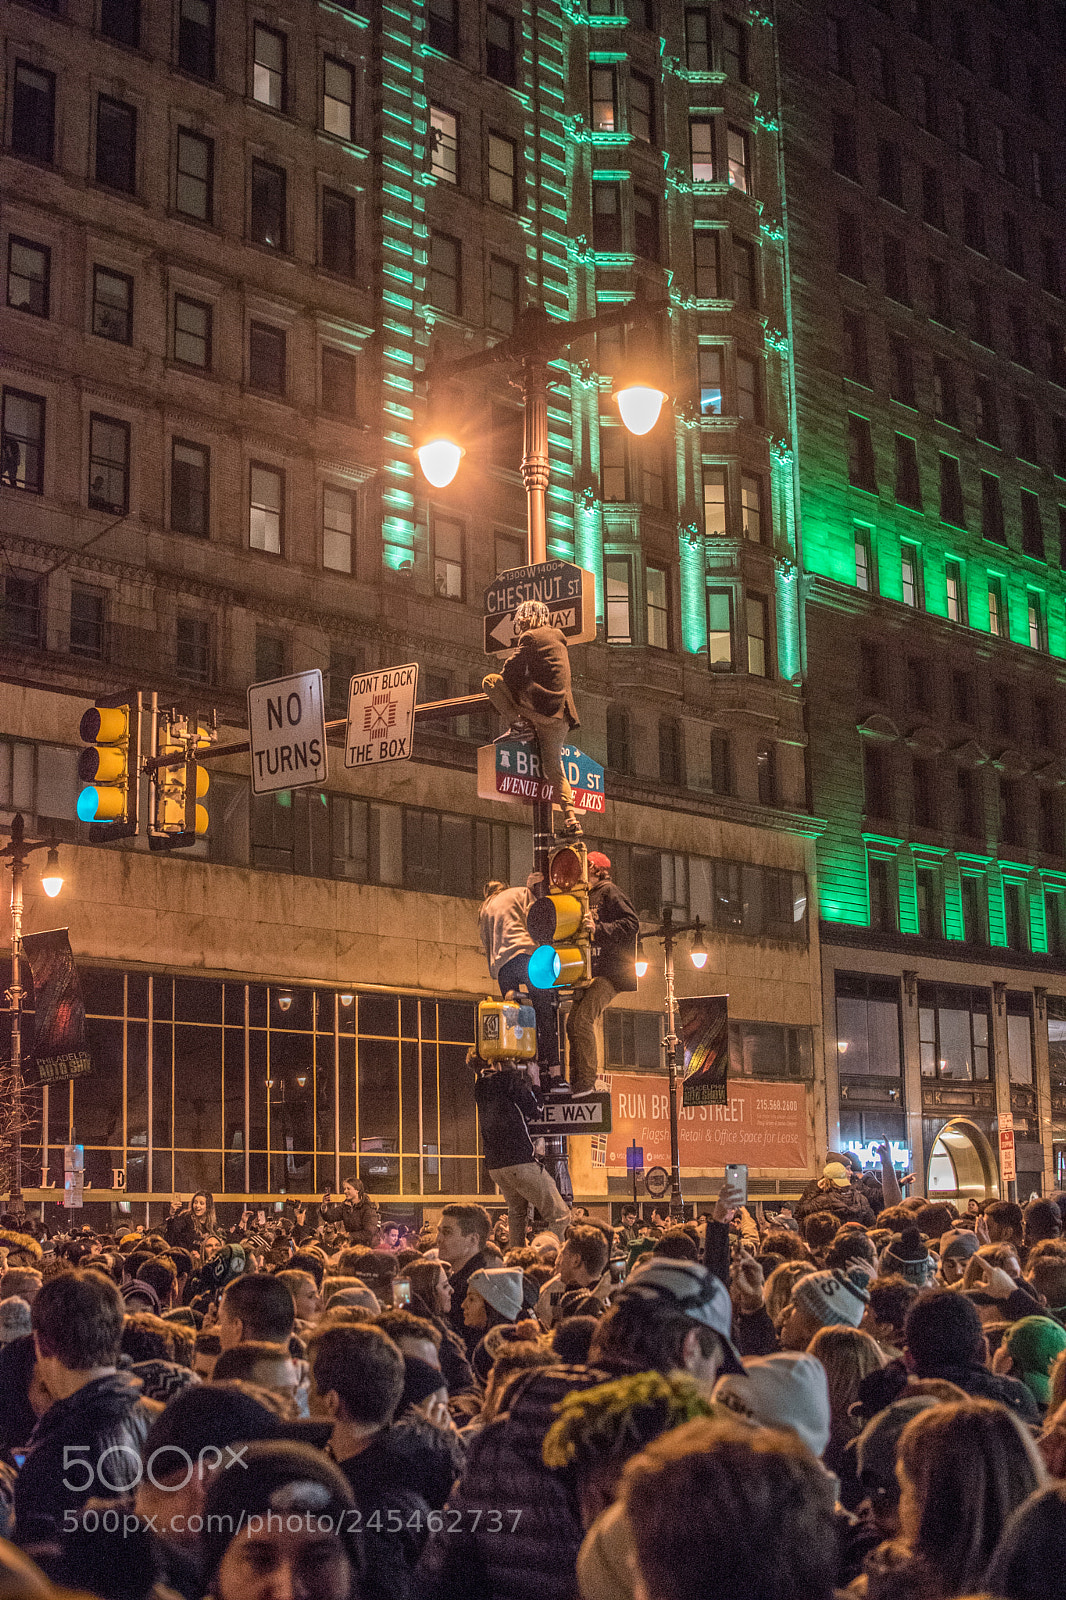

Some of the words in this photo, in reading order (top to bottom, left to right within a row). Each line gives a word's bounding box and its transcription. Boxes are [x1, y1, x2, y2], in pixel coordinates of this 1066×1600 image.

[506, 570, 526, 581] 1300
[527, 567, 537, 578] W
[537, 564, 558, 575] 1400
[487, 576, 562, 613] CHESTNUT
[567, 578, 580, 596] ST
[381, 669, 413, 690] BLOCK
[266, 692, 301, 731] NO
[255, 739, 322, 777] TURNS
[350, 743, 374, 764] THE
[379, 737, 407, 759] BOX
[516, 751, 580, 785] BRD
[586, 772, 601, 790] ST
[499, 776, 539, 798] AVENUE
[541, 784, 554, 800] OF
[580, 792, 603, 811] ARTS
[562, 1105, 597, 1122] WAY
[618, 1093, 646, 1119] RUN
[652, 1094, 695, 1121] BRAD
[700, 1098, 745, 1122] STREET
[756, 1098, 798, 1112] 215.568.2600
[641, 1126, 671, 1145] Flagsh
[680, 1128, 704, 1142] Retail
[706, 1129, 713, 1142] &
[714, 1128, 737, 1146] Office
[740, 1130, 762, 1146] Space
[762, 1130, 775, 1147] for
[777, 1133, 799, 1145] Lease
